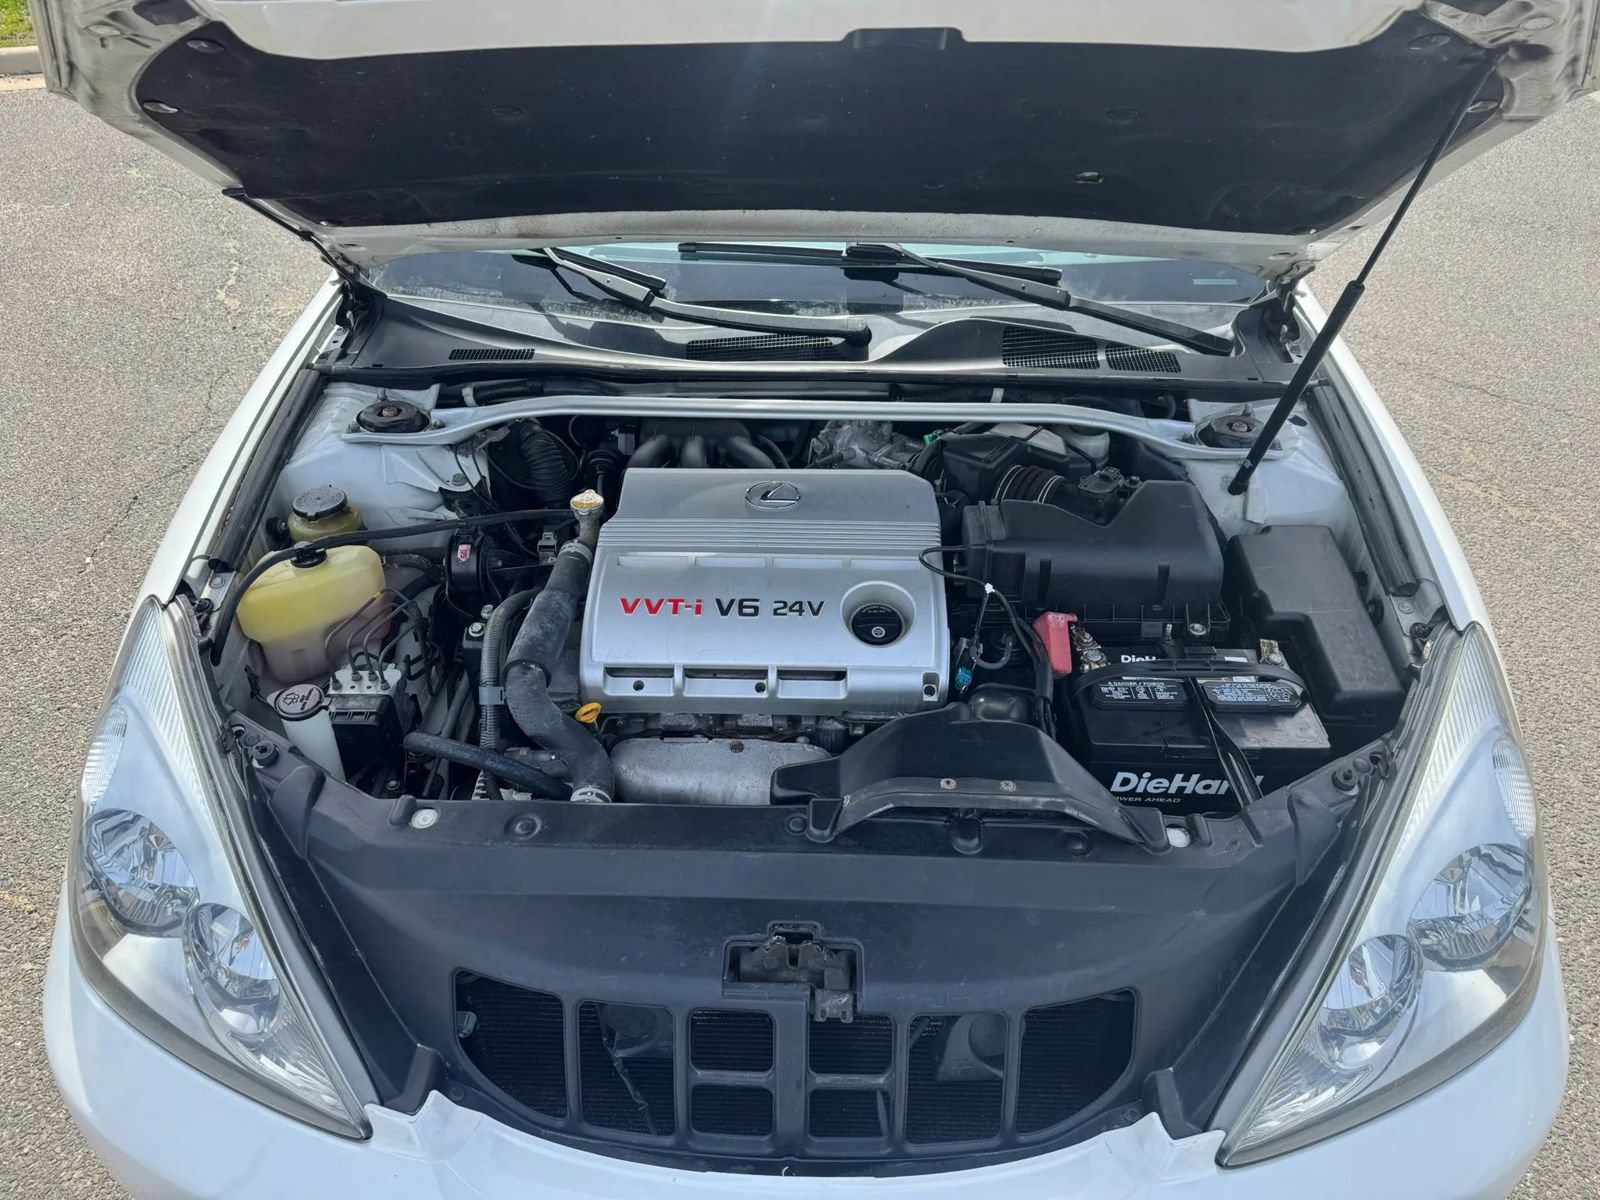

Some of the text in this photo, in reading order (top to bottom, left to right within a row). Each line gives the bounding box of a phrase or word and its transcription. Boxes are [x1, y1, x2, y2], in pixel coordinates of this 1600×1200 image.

[620, 597, 825, 617] VVT-i V6 24V
[1120, 654, 1157, 663] DieH
[1110, 771, 1264, 795] DieHar
